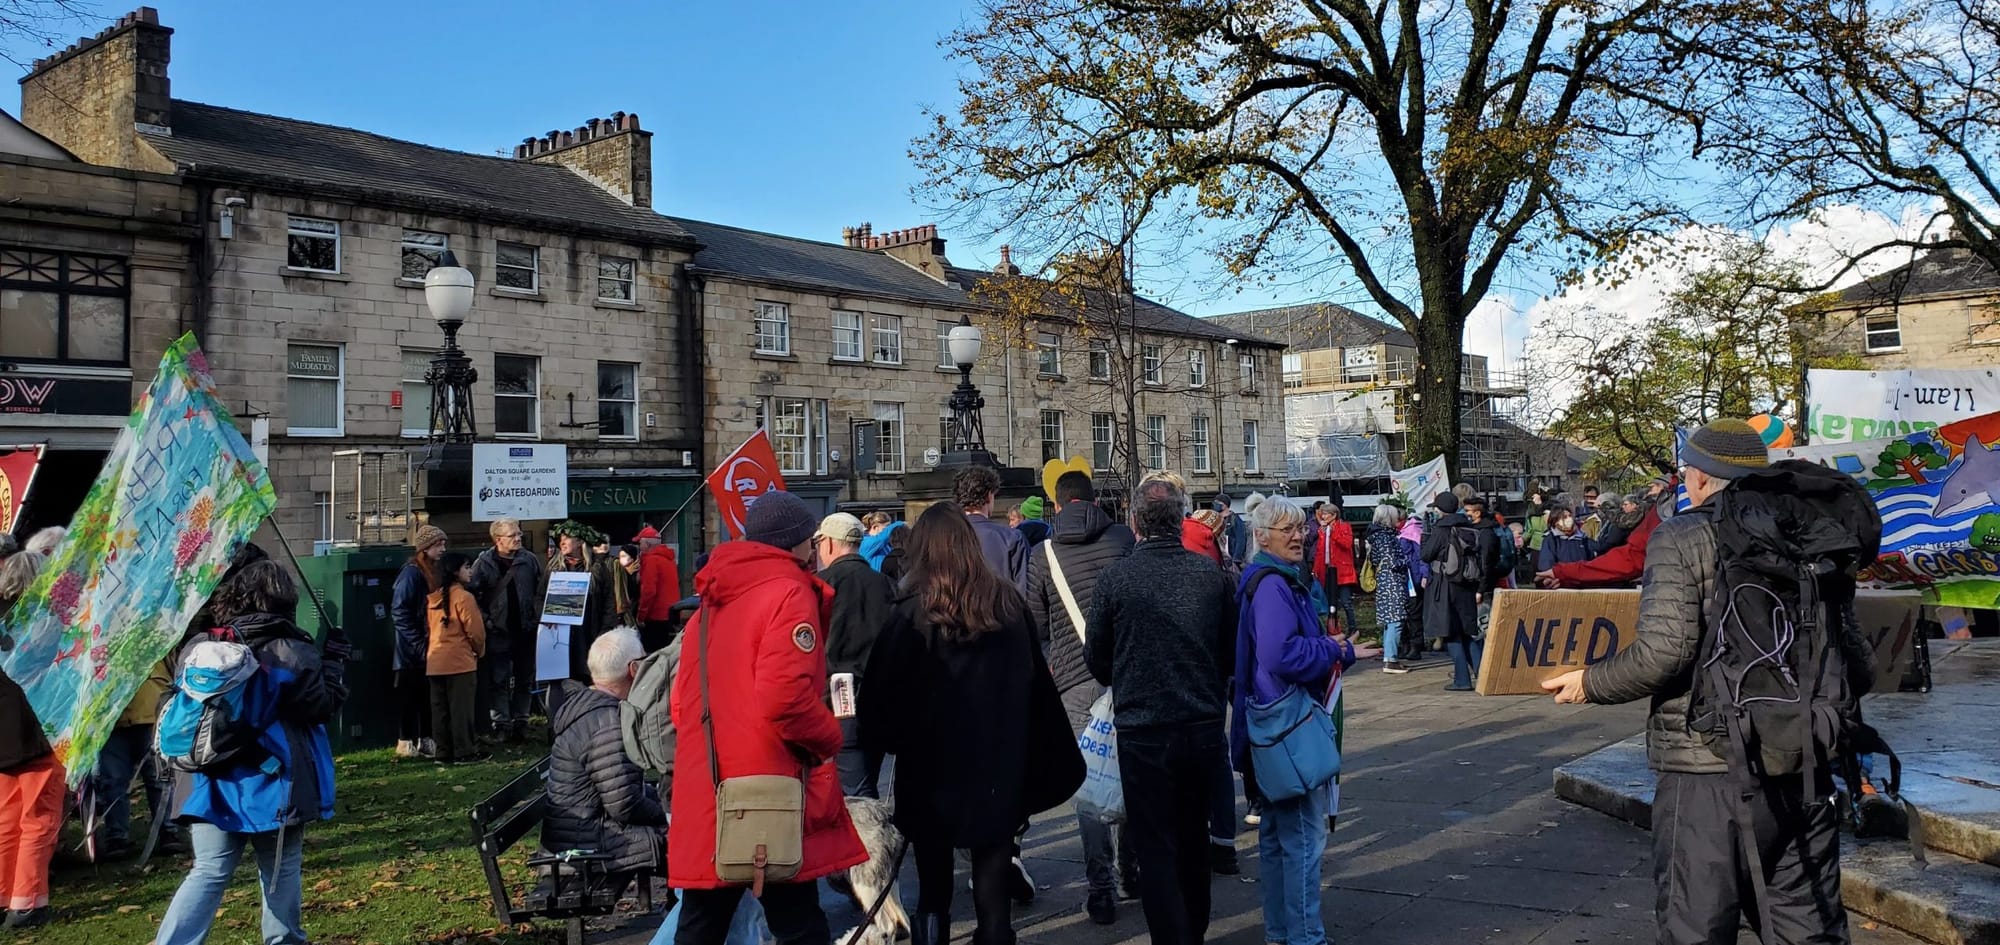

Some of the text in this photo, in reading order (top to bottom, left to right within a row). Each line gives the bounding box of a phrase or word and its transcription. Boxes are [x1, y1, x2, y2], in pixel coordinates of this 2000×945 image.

[301, 353, 331, 362] FAMILY
[289, 361, 336, 371] MEDIATION
[1809, 404, 1938, 441] urday
[495, 487, 560, 498] SKATEBOARDING
[604, 488, 647, 505] STAR
[1510, 617, 1619, 668] NEED
